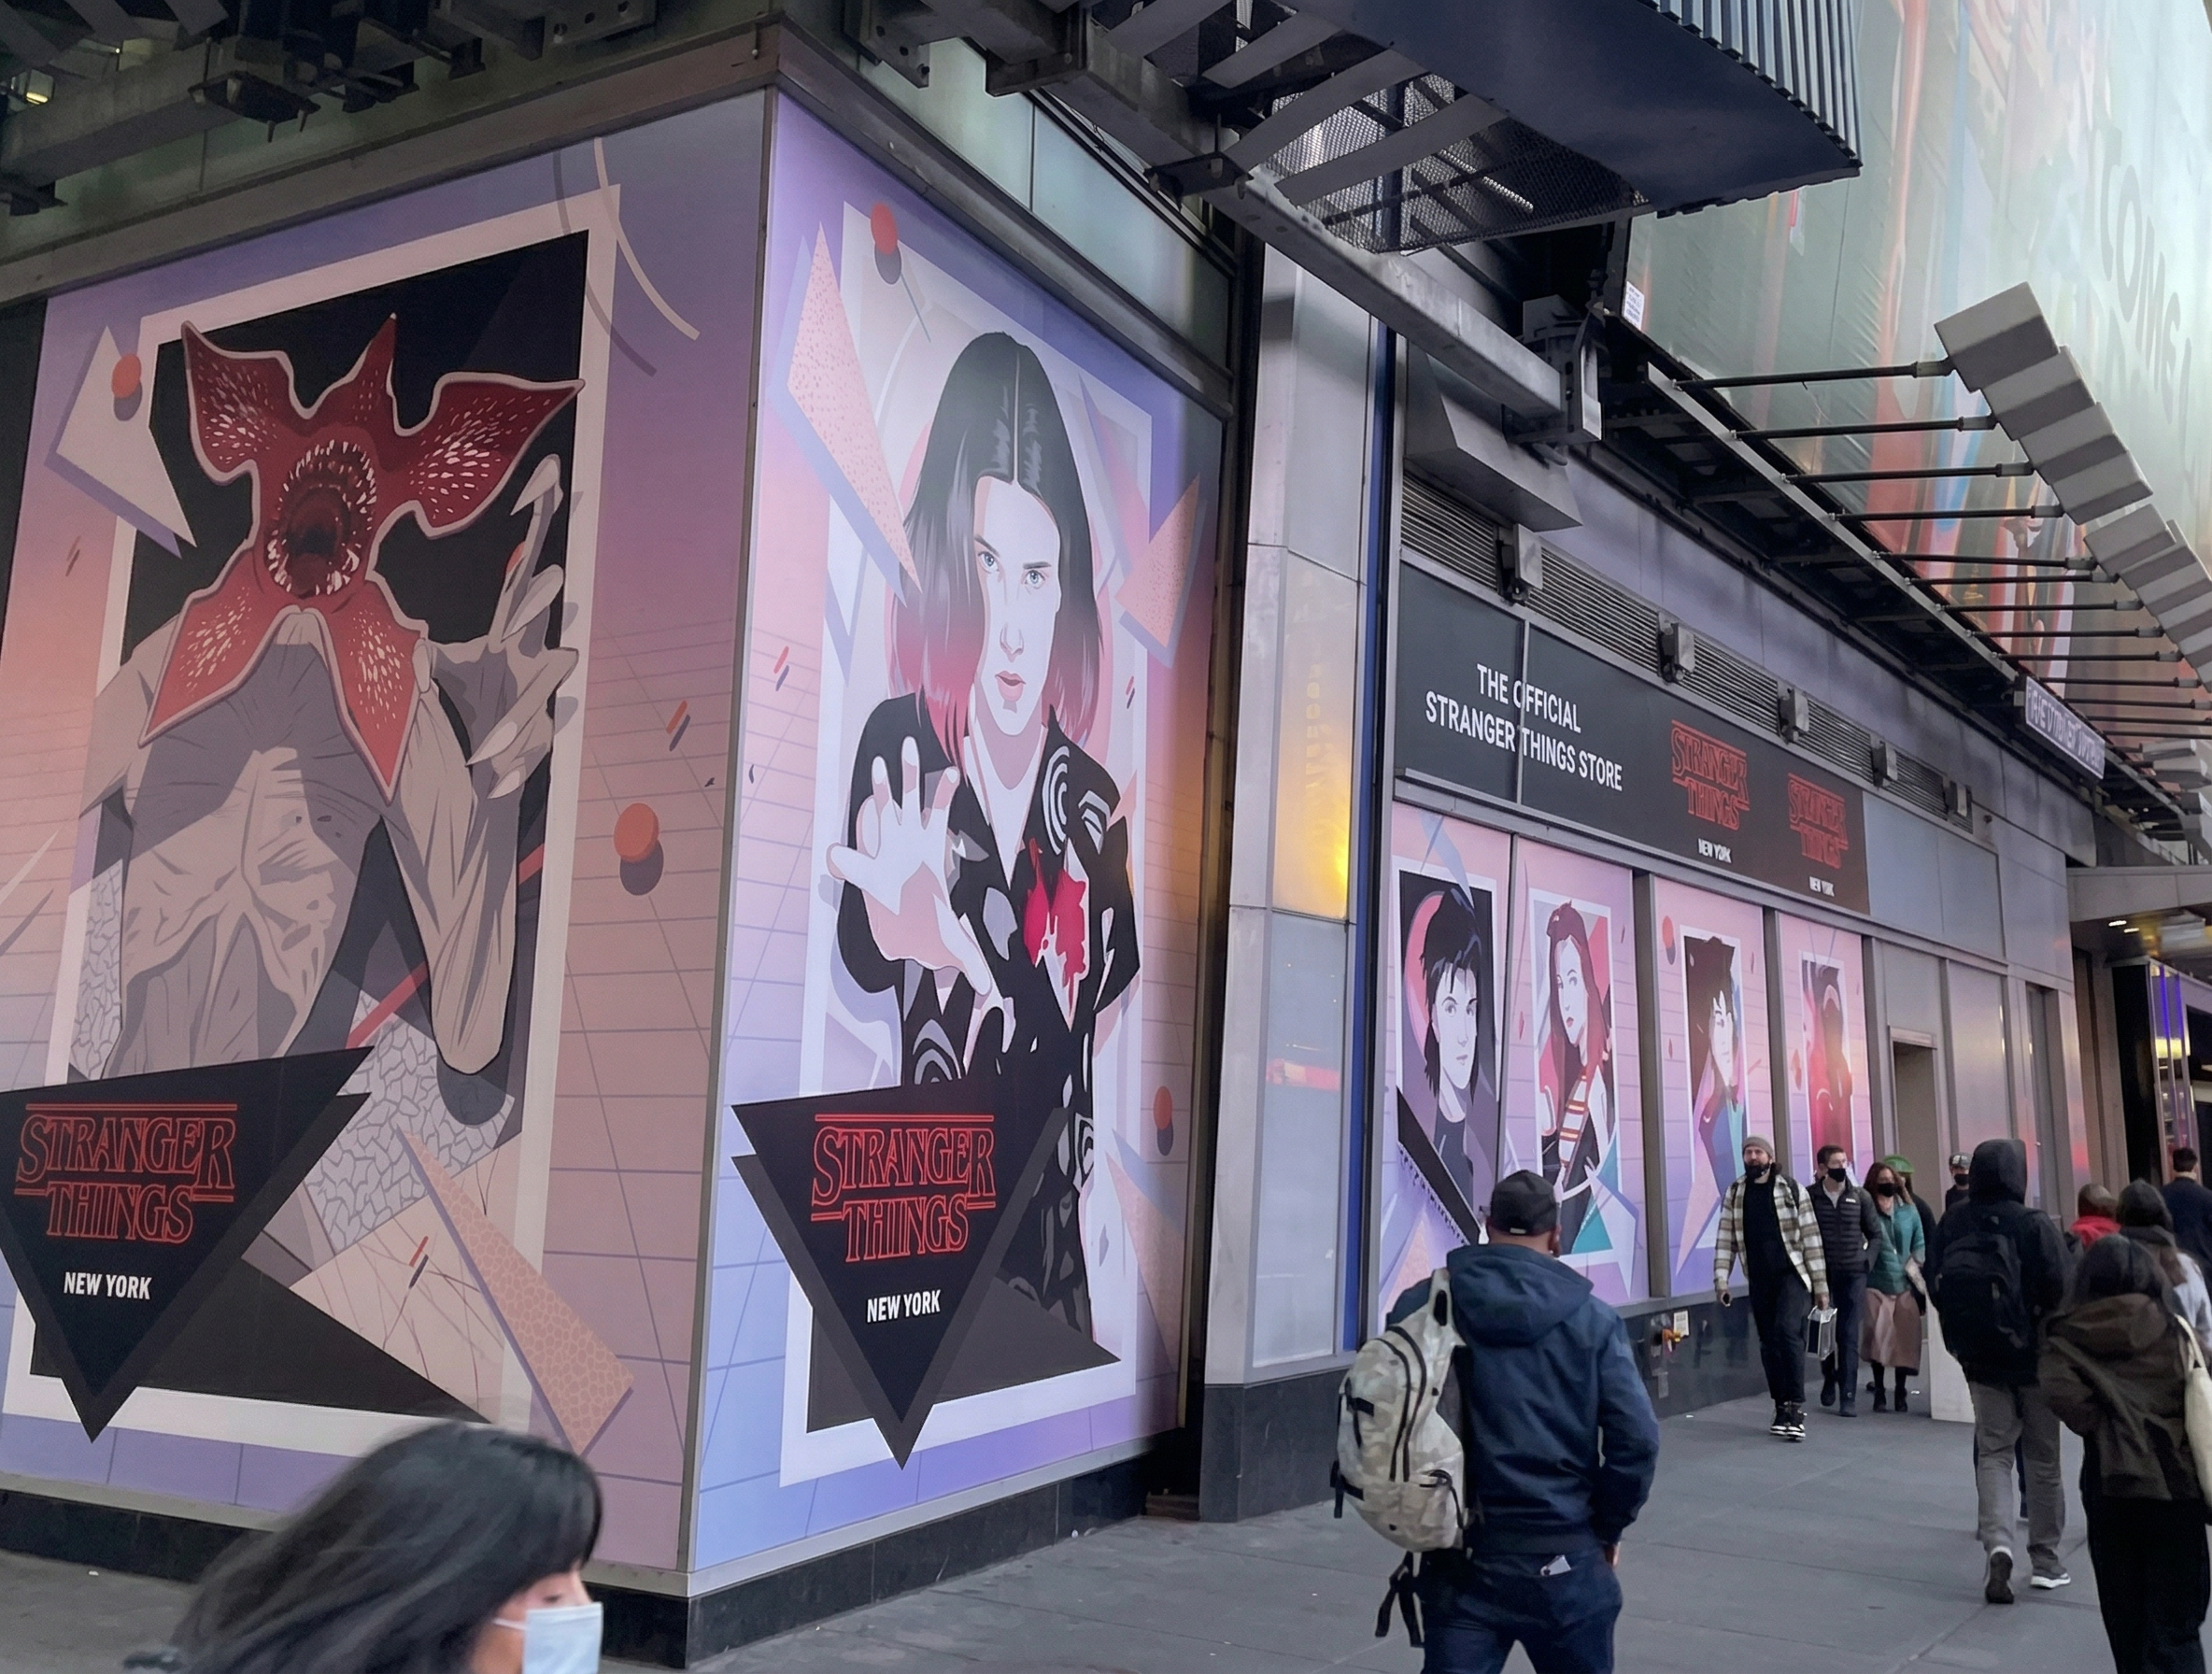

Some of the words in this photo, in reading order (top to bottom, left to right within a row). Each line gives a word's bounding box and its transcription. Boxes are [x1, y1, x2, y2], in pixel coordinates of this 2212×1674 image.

[1477, 662, 1509, 705] THE
[1512, 679, 1581, 734] OFFICIAL
[1425, 689, 1516, 753] STRANGER
[1522, 727, 1577, 774] THINGS
[1579, 749, 1623, 792] STORE
[1671, 727, 1750, 805] STRANGER
[1685, 776, 1740, 830] THINGS
[16, 1114, 236, 1190] STRANGER
[812, 1126, 997, 1206] STRANGER
[45, 1181, 194, 1244] THINGS
[841, 1192, 969, 1262] THINGS
[64, 1271, 102, 1296] NEW
[106, 1274, 152, 1300] YORK
[867, 1295, 900, 1323] NEW
[903, 1289, 942, 1317] YORK
